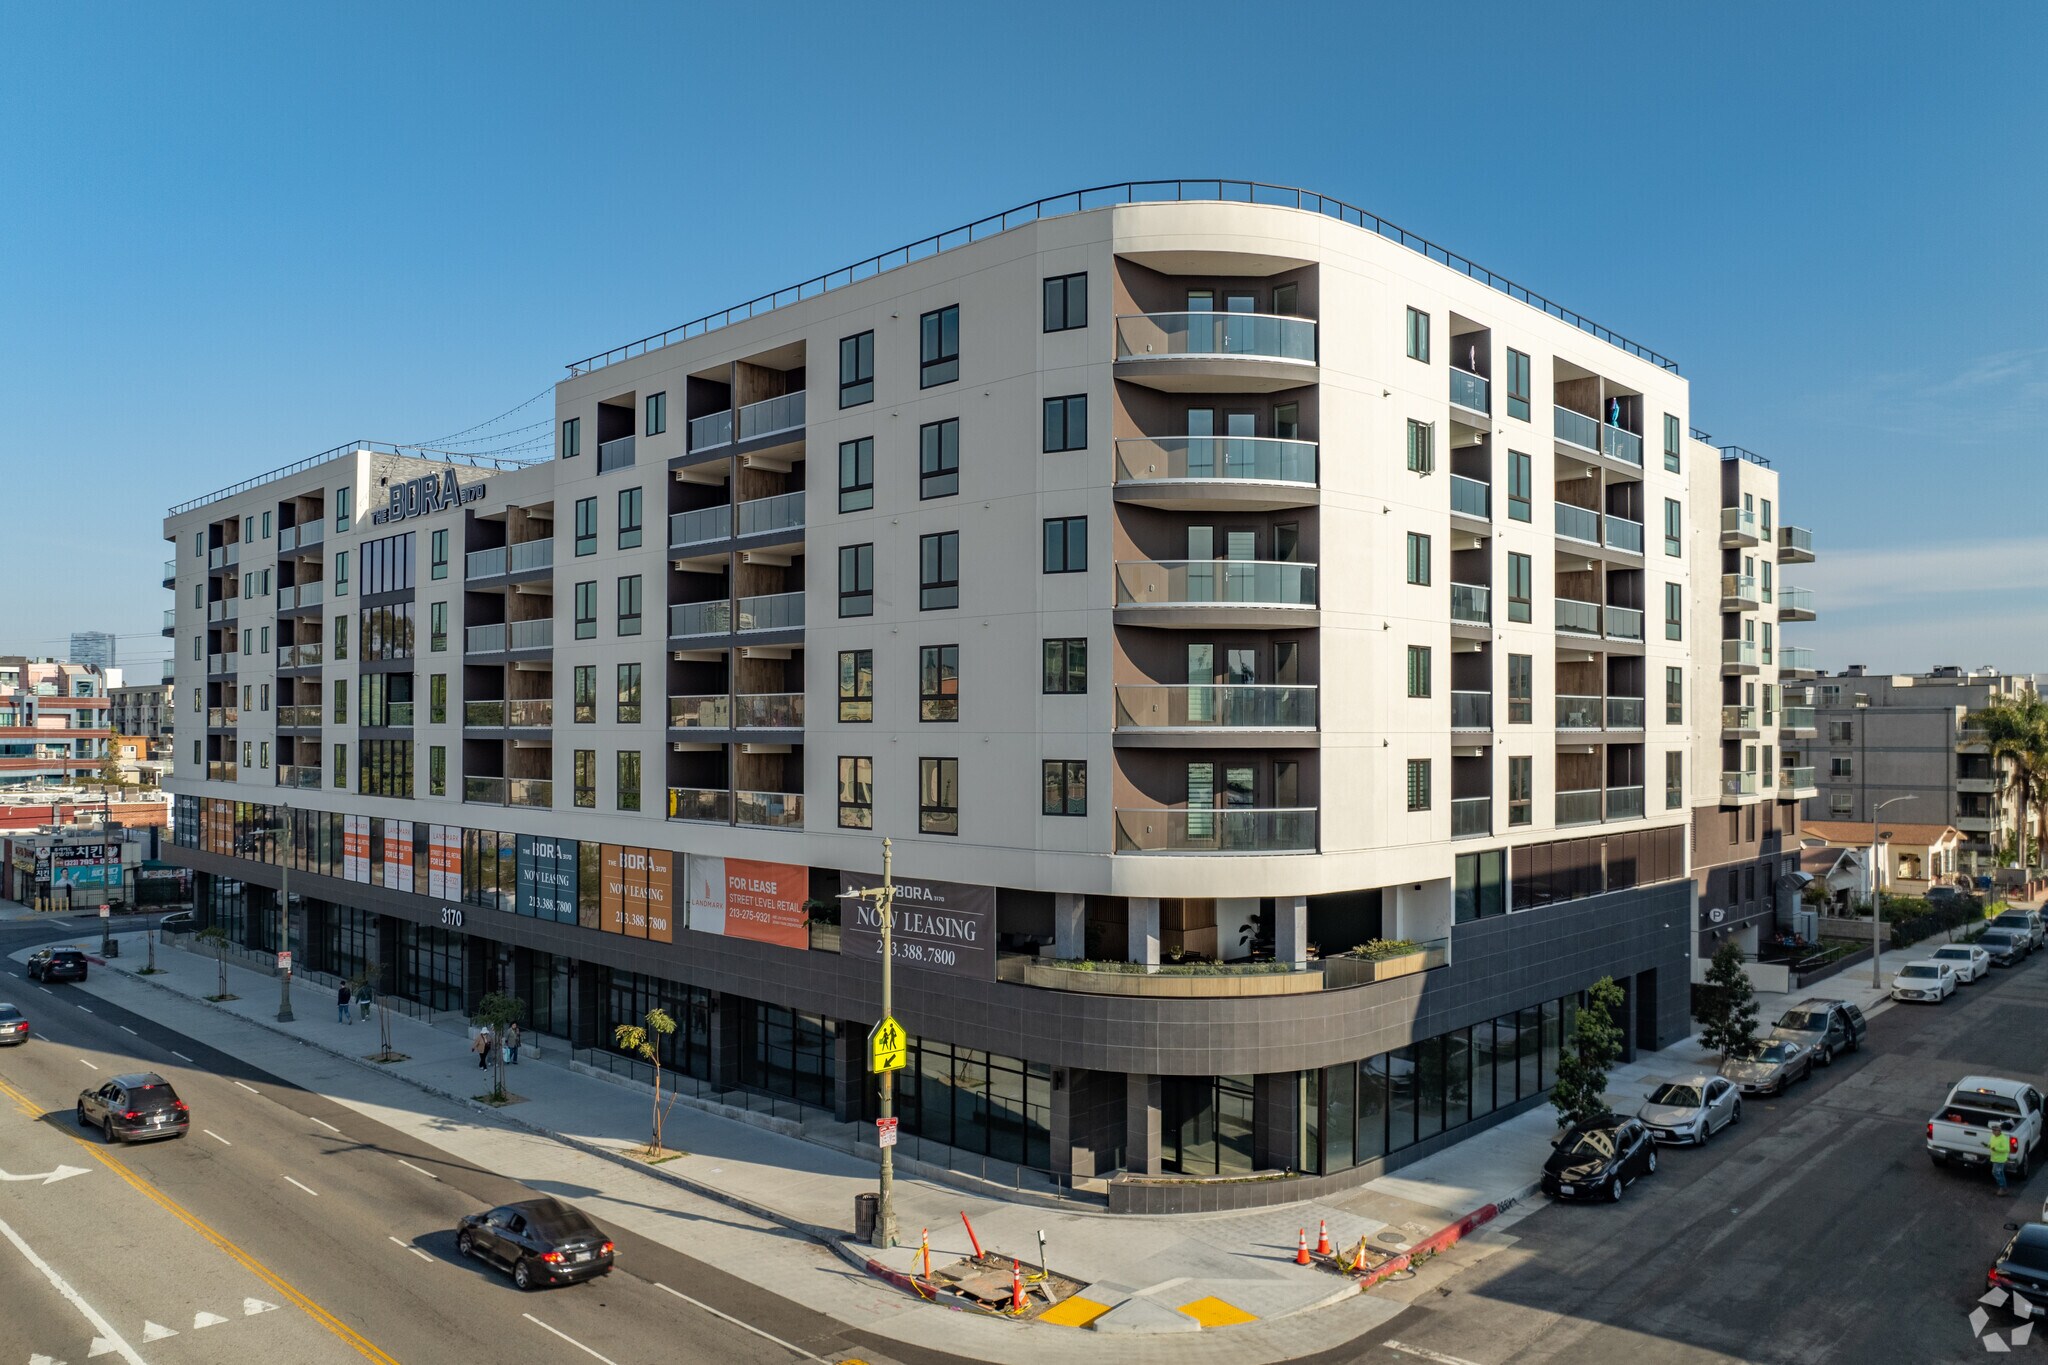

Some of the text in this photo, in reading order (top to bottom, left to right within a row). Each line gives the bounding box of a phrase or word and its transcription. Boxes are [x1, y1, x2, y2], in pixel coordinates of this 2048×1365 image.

[371, 468, 485, 525] THE BORA 3170
[76, 845, 103, 858] 치킨
[352, 845, 362, 854] LESE
[385, 850, 404, 860] FOR LESE
[532, 842, 562, 860] BORA
[430, 857, 452, 868] FOR LESE
[608, 852, 667, 873] THE BORA 3170
[541, 871, 569, 887] LEASING
[729, 876, 777, 895] FOR LEASE
[630, 884, 664, 902] LEASING
[895, 884, 945, 903] BORA 3170
[691, 899, 724, 910] LANDMARK
[729, 893, 801, 913] STREET LEVEL RETAIL
[441, 907, 462, 927] 3170
[615, 910, 667, 931] 213.388.7800
[729, 907, 770, 923] 213-275-9321
[903, 912, 976, 942] LEASING
[876, 939, 956, 967] 23.388.7800
